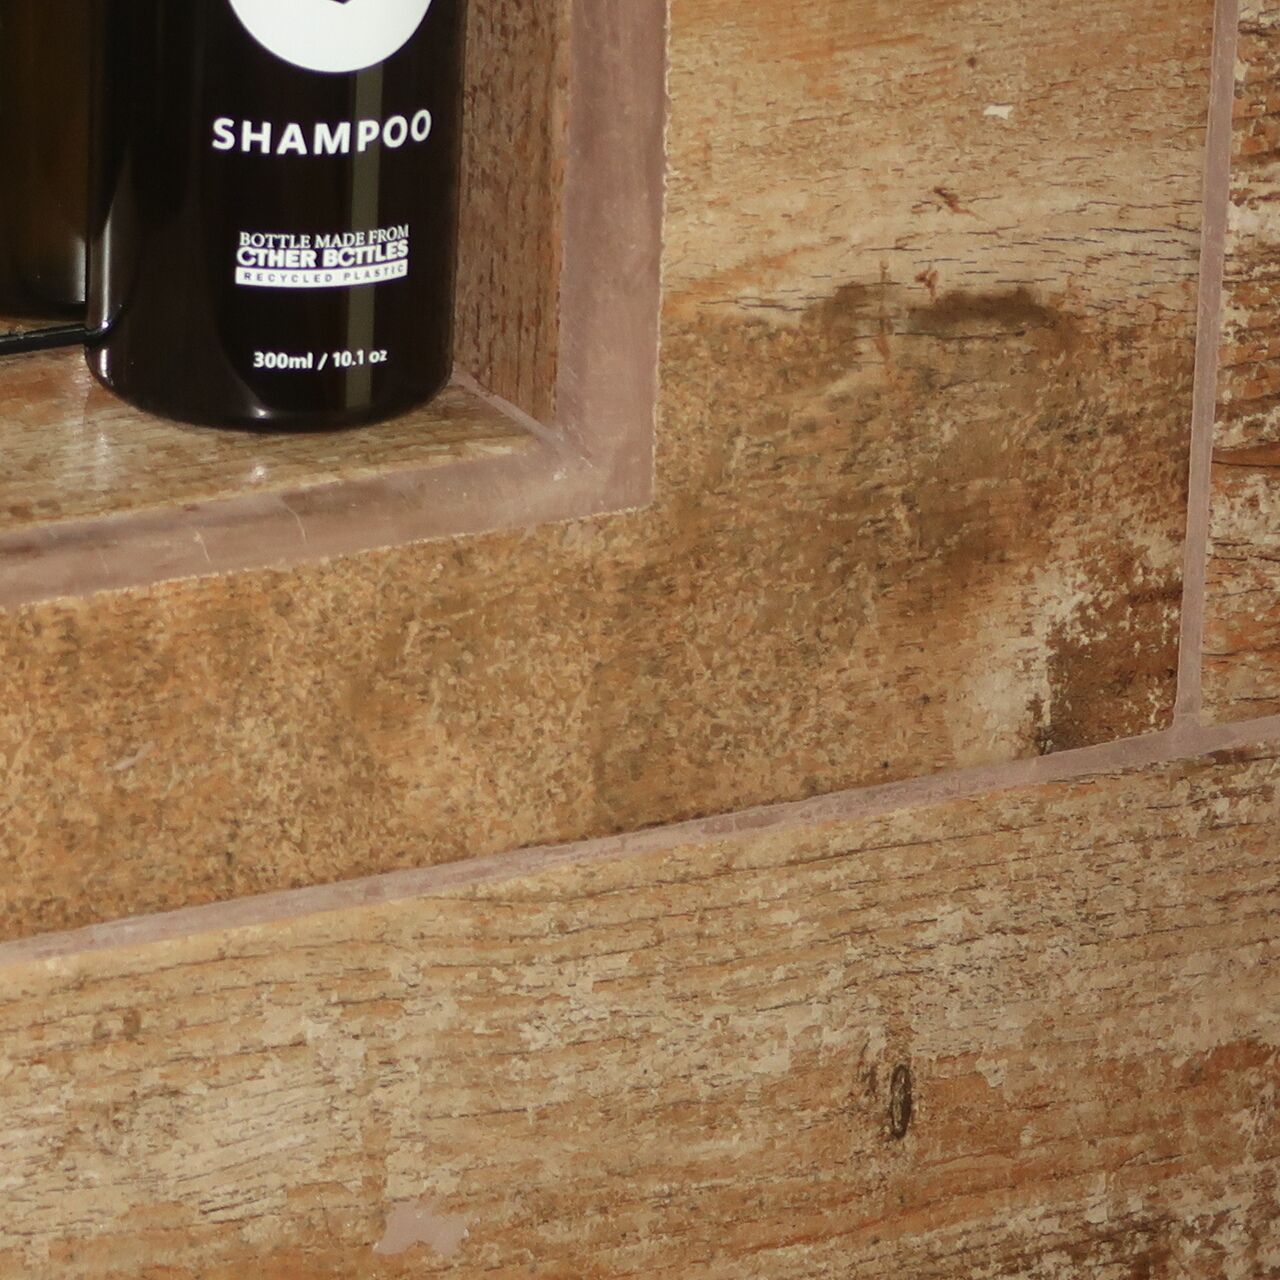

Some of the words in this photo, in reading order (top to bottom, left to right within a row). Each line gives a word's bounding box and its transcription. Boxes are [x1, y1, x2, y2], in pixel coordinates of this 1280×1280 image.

[211, 110, 432, 156] SHAMPOO
[239, 231, 311, 249] BOTTLE
[315, 232, 366, 249] MADE
[369, 223, 410, 243] FROM
[243, 272, 333, 283] RECYCLED
[343, 264, 404, 281] PLASTIC
[253, 351, 313, 369] 300ml
[317, 352, 329, 371] /
[332, 349, 364, 367] 10.1
[368, 349, 388, 364] oz
